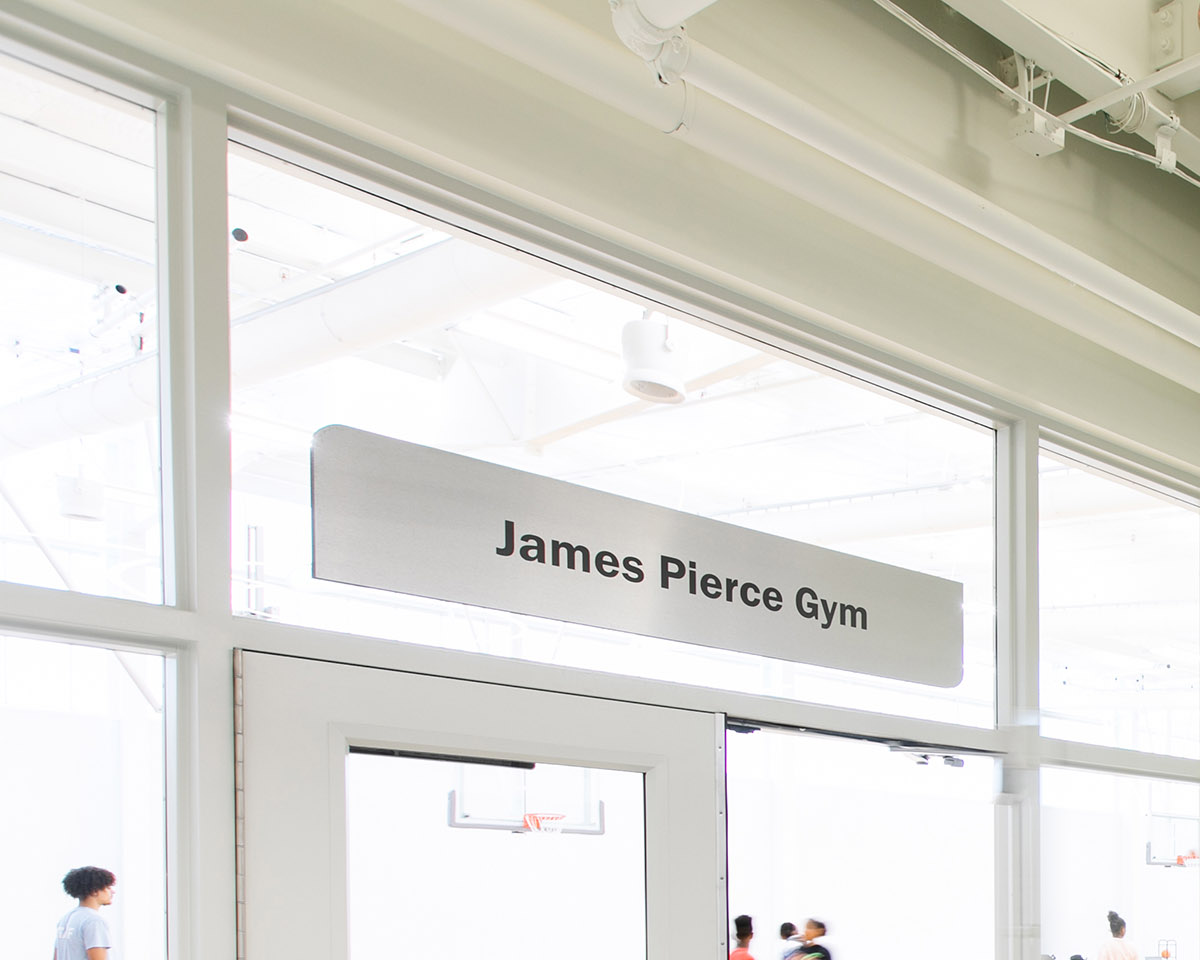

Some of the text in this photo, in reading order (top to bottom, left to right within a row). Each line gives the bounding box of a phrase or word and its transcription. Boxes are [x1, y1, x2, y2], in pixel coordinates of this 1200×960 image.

[496, 520, 868, 631] James Pierce Gym
